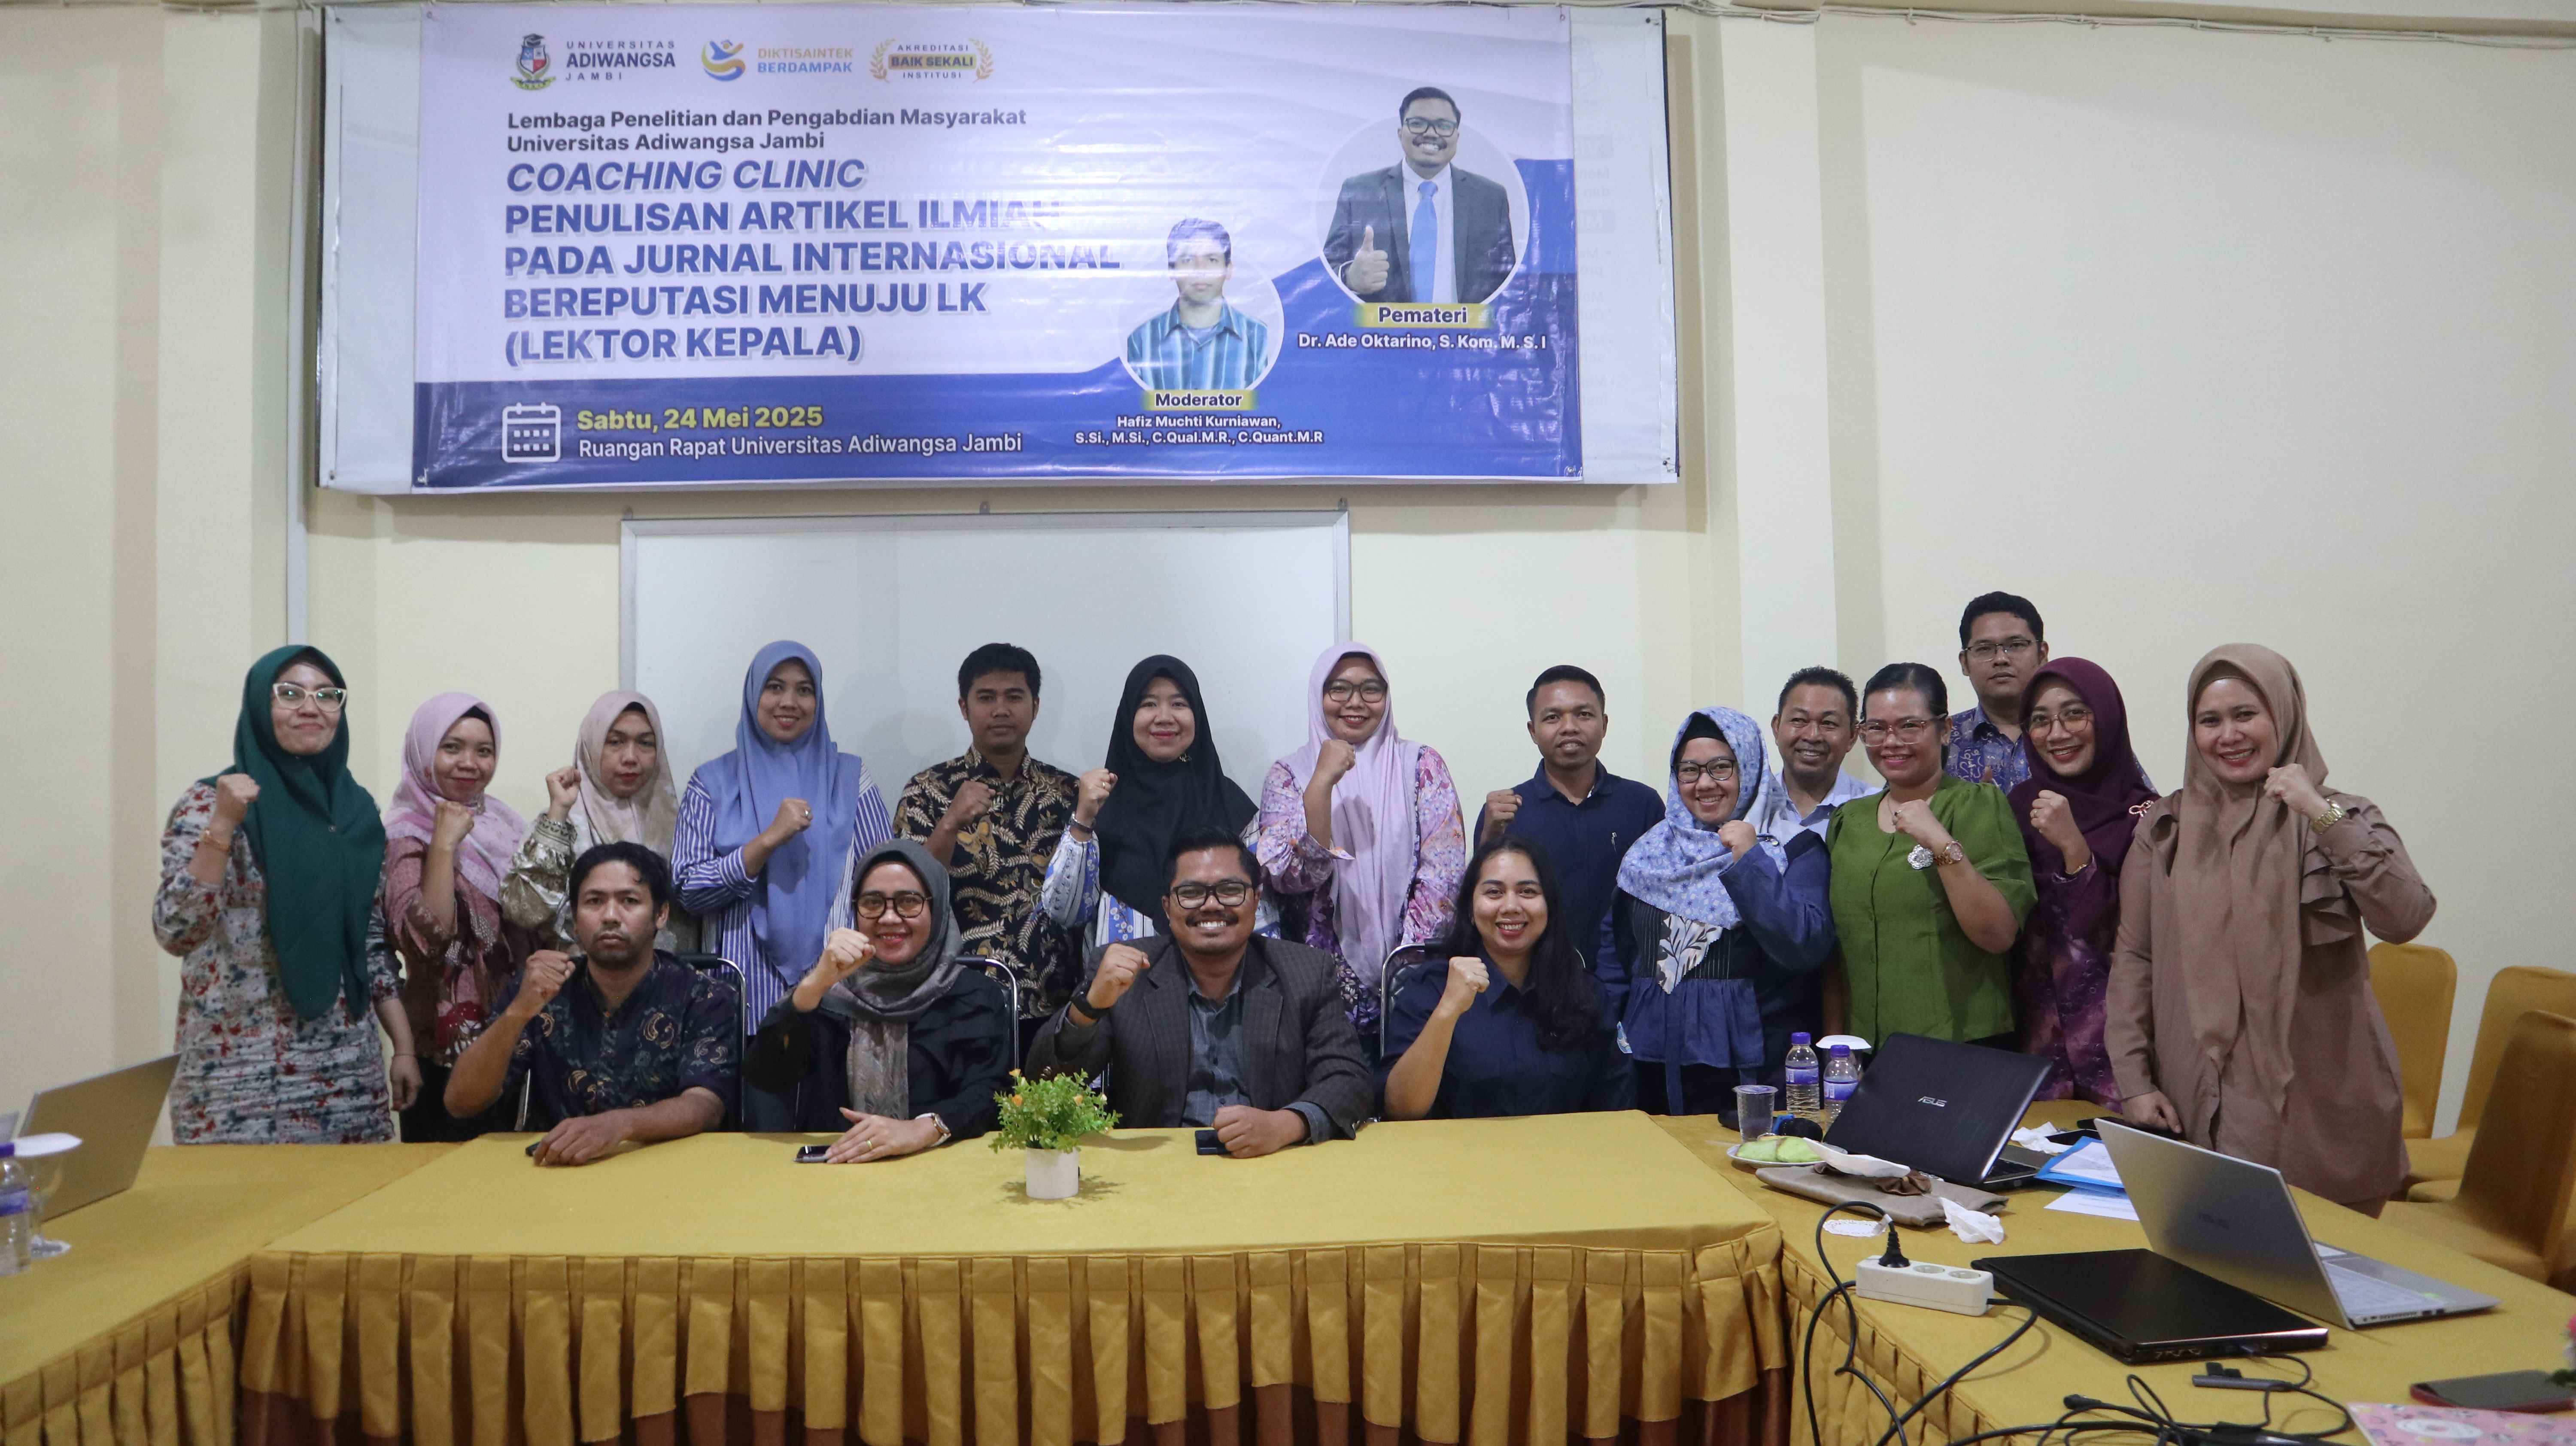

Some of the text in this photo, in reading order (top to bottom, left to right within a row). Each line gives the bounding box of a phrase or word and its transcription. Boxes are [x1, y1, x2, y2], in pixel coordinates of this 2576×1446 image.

[567, 53, 675, 67] ADIWANGSA
[759, 48, 852, 58] DIKTISAINTEK
[758, 62, 852, 73] BERDAMPAK
[891, 56, 972, 67] BAIK SEKALI
[509, 109, 1025, 132] Lembaga Penelitian dan Pengabdian Masyarakat
[508, 132, 823, 153] Universitas Adiwangsa Jambi
[507, 159, 864, 191] COACHING CLINIC
[506, 203, 728, 233] PENULISAN
[739, 201, 908, 230] ARTIKEL
[506, 242, 1120, 275] PADA JURNAL INTERNASIONAL
[505, 283, 986, 318] BEREPUTASI MENUJU LK
[1379, 307, 1466, 322] Pemateri
[506, 326, 860, 366] (LEKTOR KEPALA)
[1300, 334, 1321, 346] Dr.
[1325, 334, 1357, 346] Ade
[1361, 334, 1435, 350] Oktarino,
[1440, 335, 1454, 347] S.
[1501, 335, 1519, 348] M.
[1524, 336, 1538, 348] S.
[1542, 336, 1546, 349] I
[1156, 394, 1242, 406] Moderator
[577, 406, 823, 433] Sabtu, 24 Mei 2025
[1118, 416, 1280, 428] Hafiz Muchti Kurniawan,
[1076, 431, 1322, 445] S.Si., M.Si., C.Qual.M.R., C.Quant.M.R
[580, 433, 1021, 460] Ruangan Rapat Universitas Adiwangsa Jambi
[1917, 1096, 1947, 1107] ASUS
